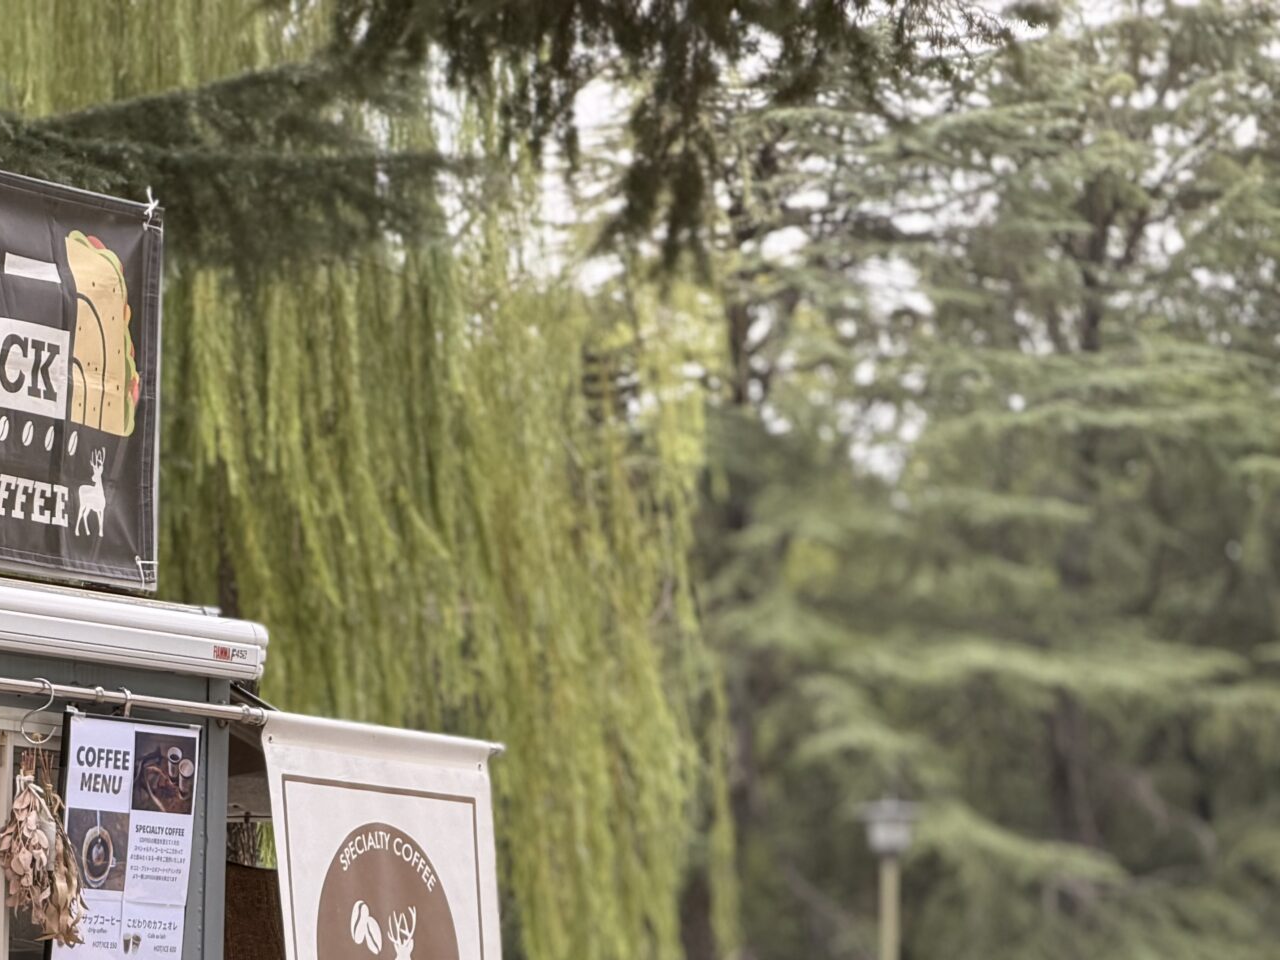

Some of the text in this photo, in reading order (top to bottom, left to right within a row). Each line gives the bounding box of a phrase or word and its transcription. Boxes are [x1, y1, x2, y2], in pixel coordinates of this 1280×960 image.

[76, 745, 130, 771] COFFEE
[80, 772, 123, 795] MENU
[165, 826, 185, 837] COFFEE
[339, 831, 437, 892] SPECIALTY COFFEE
[127, 918, 178, 930] こだわりのカフェオレ
